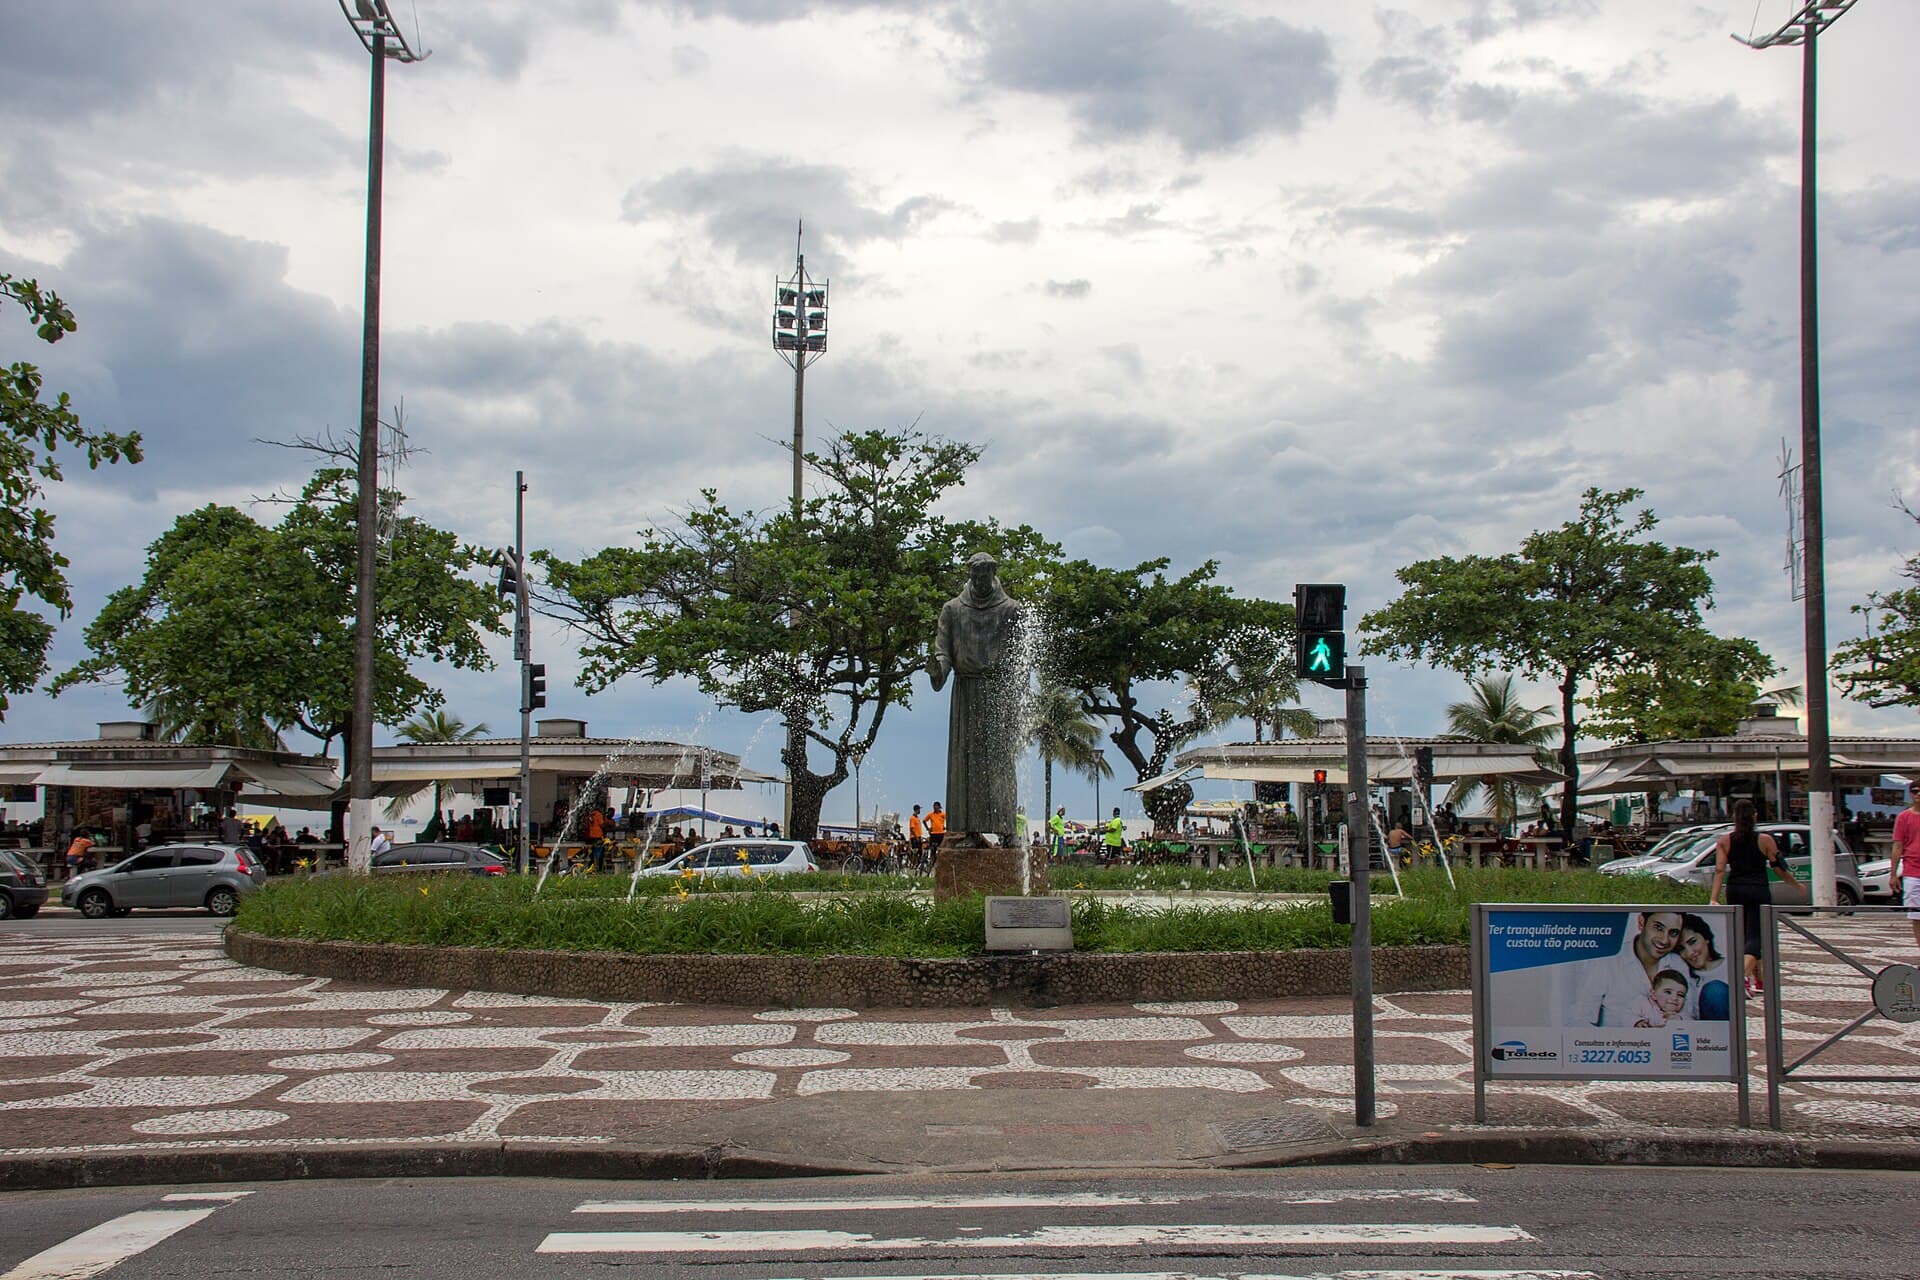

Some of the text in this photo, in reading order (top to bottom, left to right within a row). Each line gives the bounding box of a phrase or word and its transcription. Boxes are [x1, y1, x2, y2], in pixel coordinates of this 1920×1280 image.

[1488, 924, 1612, 938] Ter tranquilidade nunca
[1506, 937, 1599, 950] custou tão pouco.
[1568, 1050, 1651, 1063] 13 3227.6053
